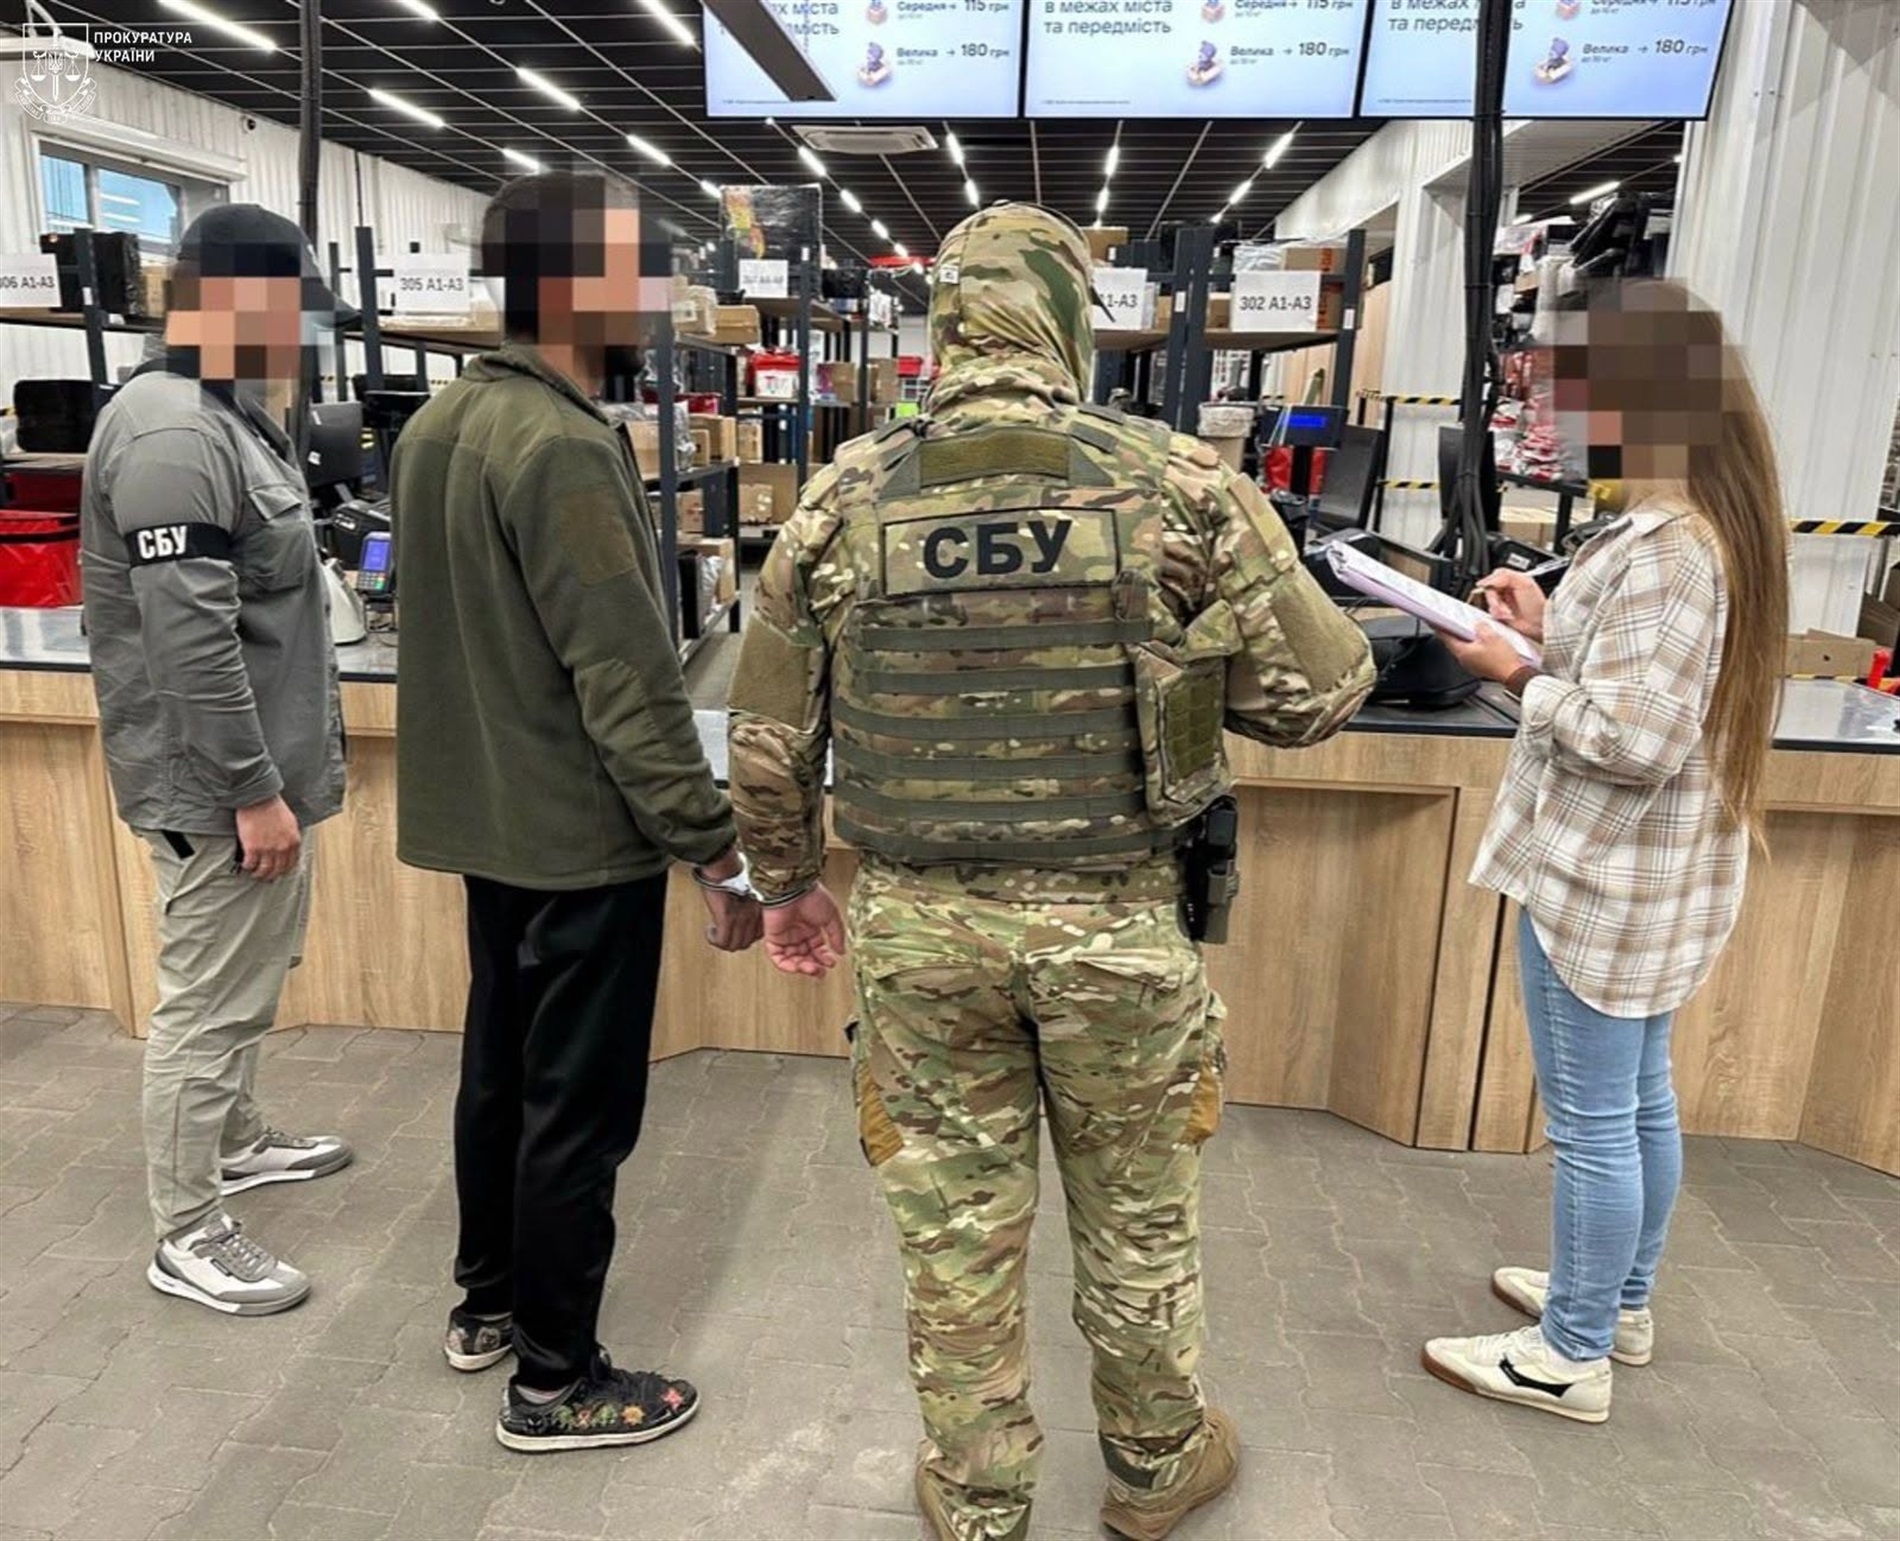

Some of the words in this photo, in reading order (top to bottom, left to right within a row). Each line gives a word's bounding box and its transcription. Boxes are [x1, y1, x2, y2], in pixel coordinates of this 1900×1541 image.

[964, 0, 986, 11] 115
[1045, 1, 1055, 13] в
[1060, 1, 1119, 13] межах
[1124, 0, 1173, 13] міста
[1044, 21, 1064, 34] та
[1068, 18, 1172, 36] передмість
[1388, 18, 1409, 31] та
[961, 43, 988, 56] 180
[1298, 42, 1327, 56] 180
[1655, 39, 1685, 54] 180
[1240, 295, 1265, 311] 302
[137, 525, 188, 559] СБУ
[923, 519, 1073, 580] СБУ
